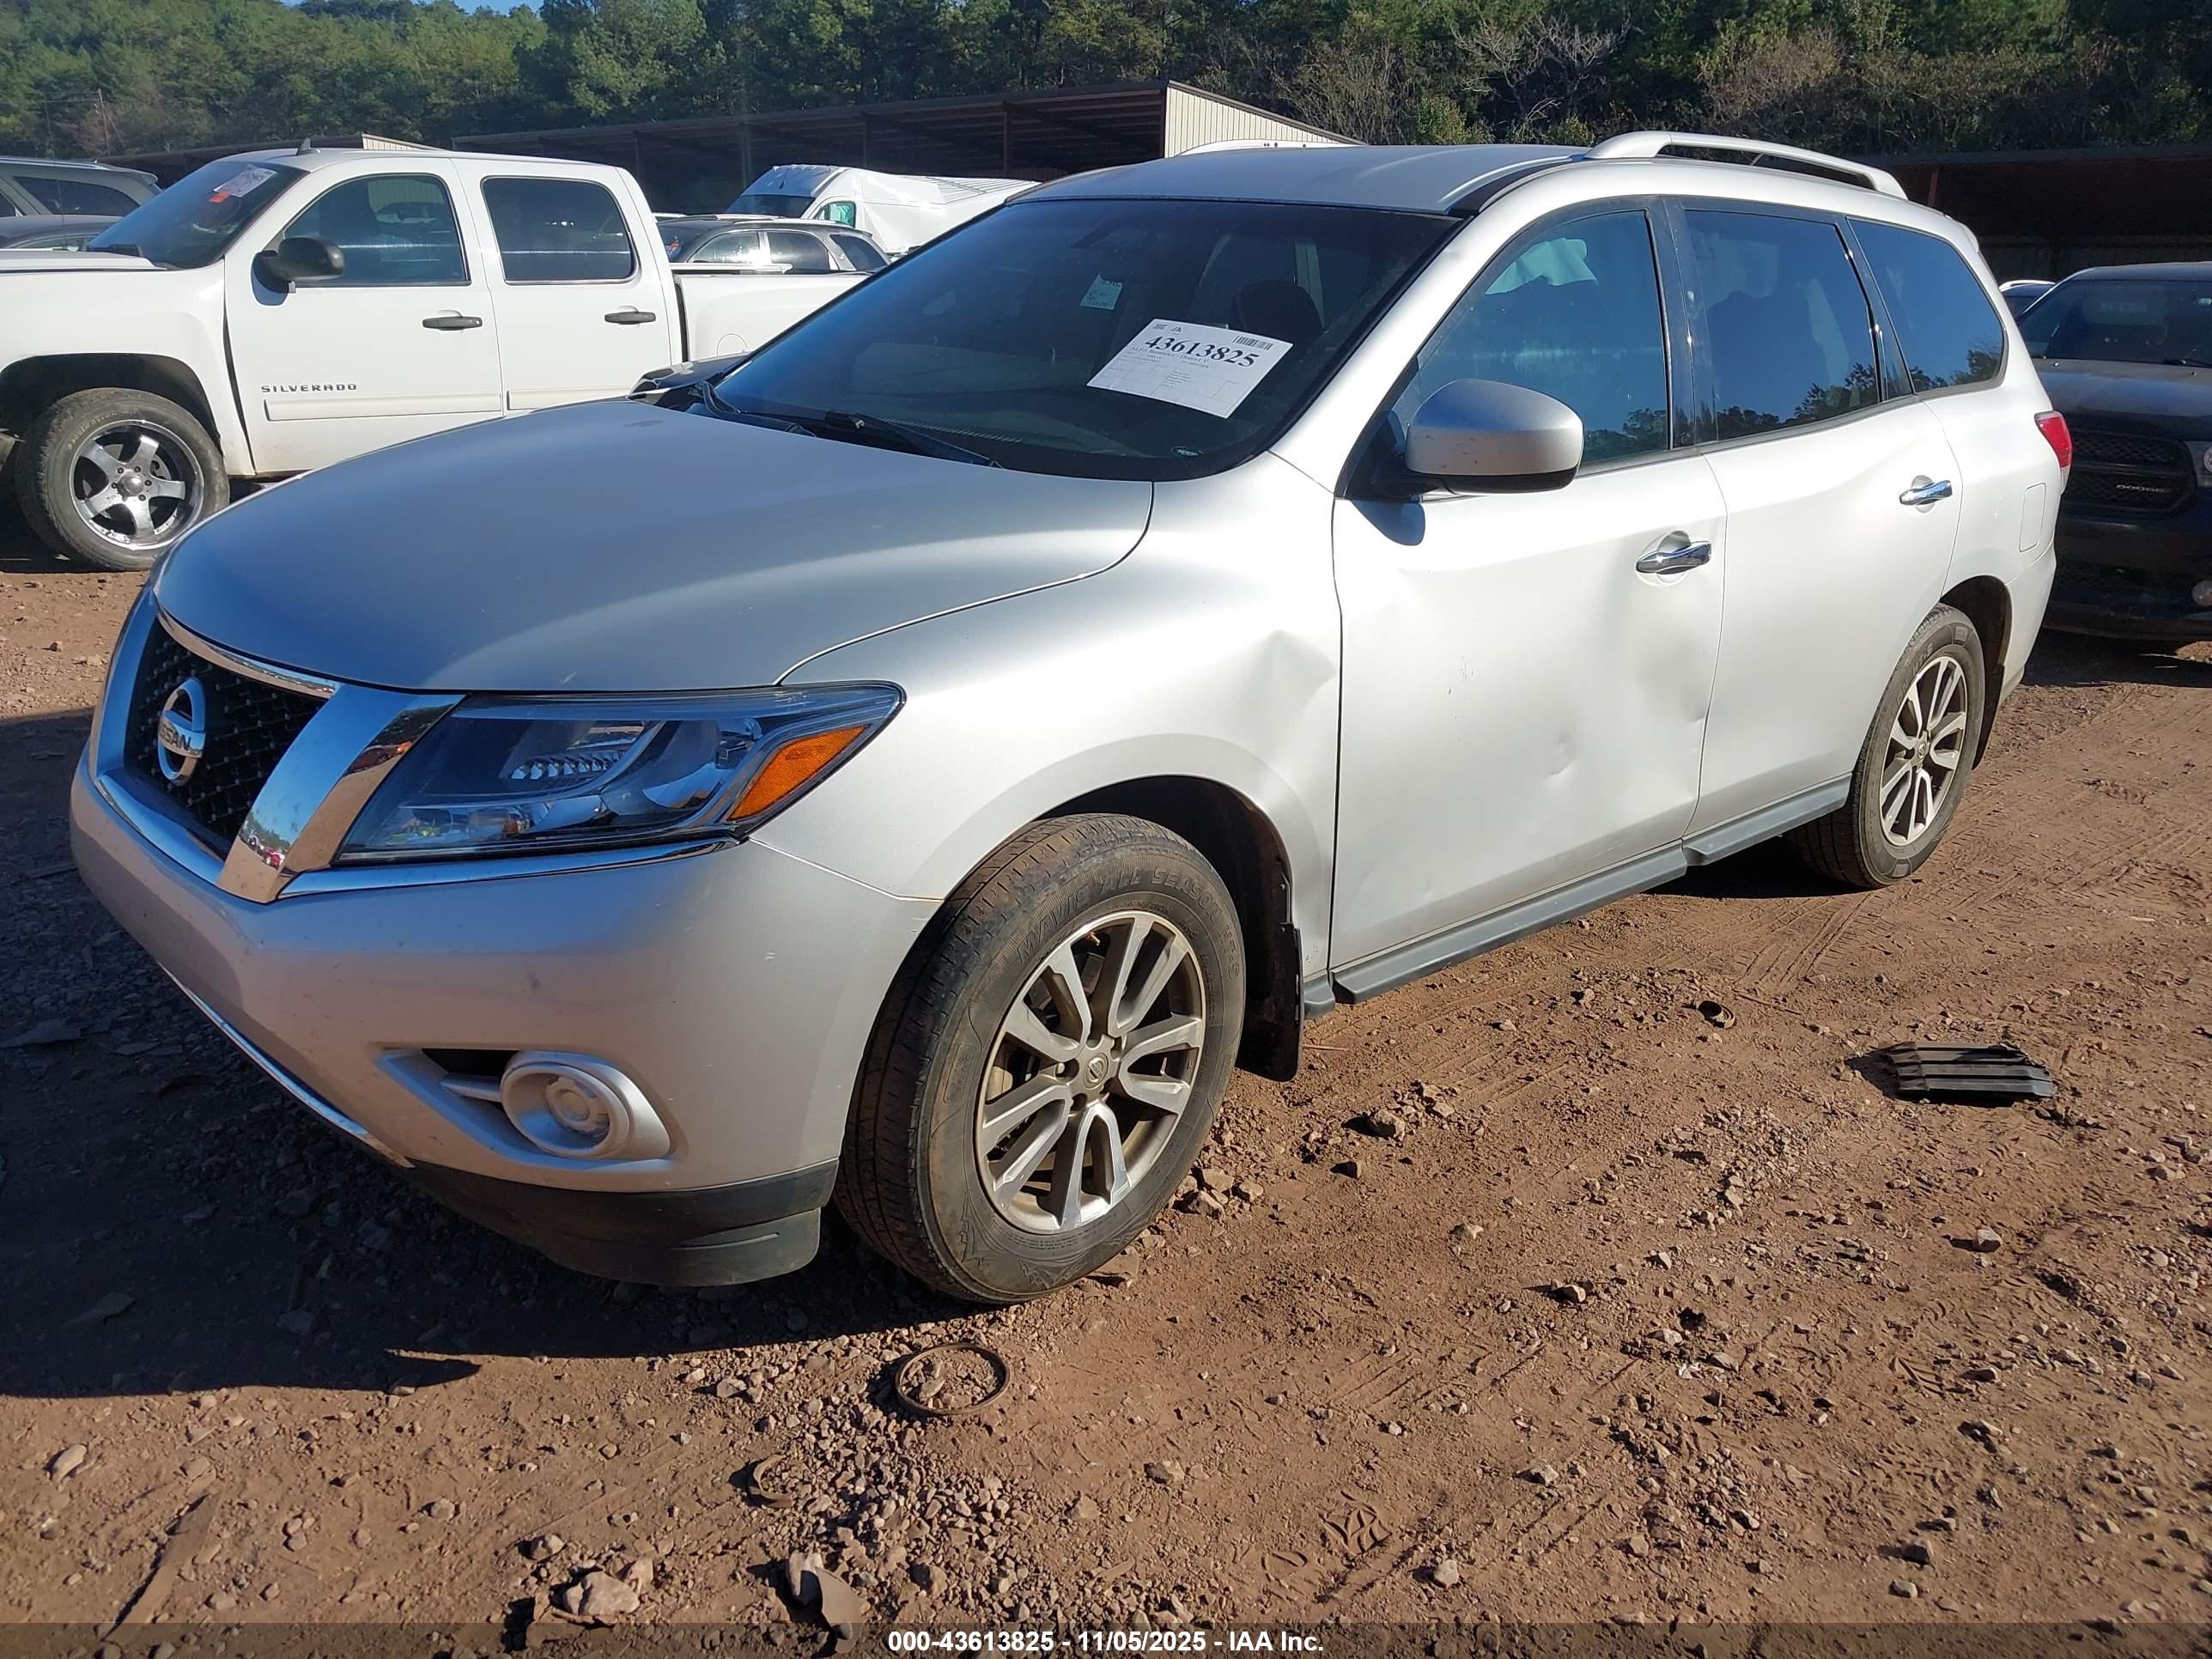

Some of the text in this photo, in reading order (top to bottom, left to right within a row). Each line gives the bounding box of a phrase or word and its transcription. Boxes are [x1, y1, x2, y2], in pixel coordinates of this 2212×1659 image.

[1145, 336, 1261, 368] 43613825
[260, 383, 357, 393] SILVERADO
[1151, 866, 1223, 921] SEASON
